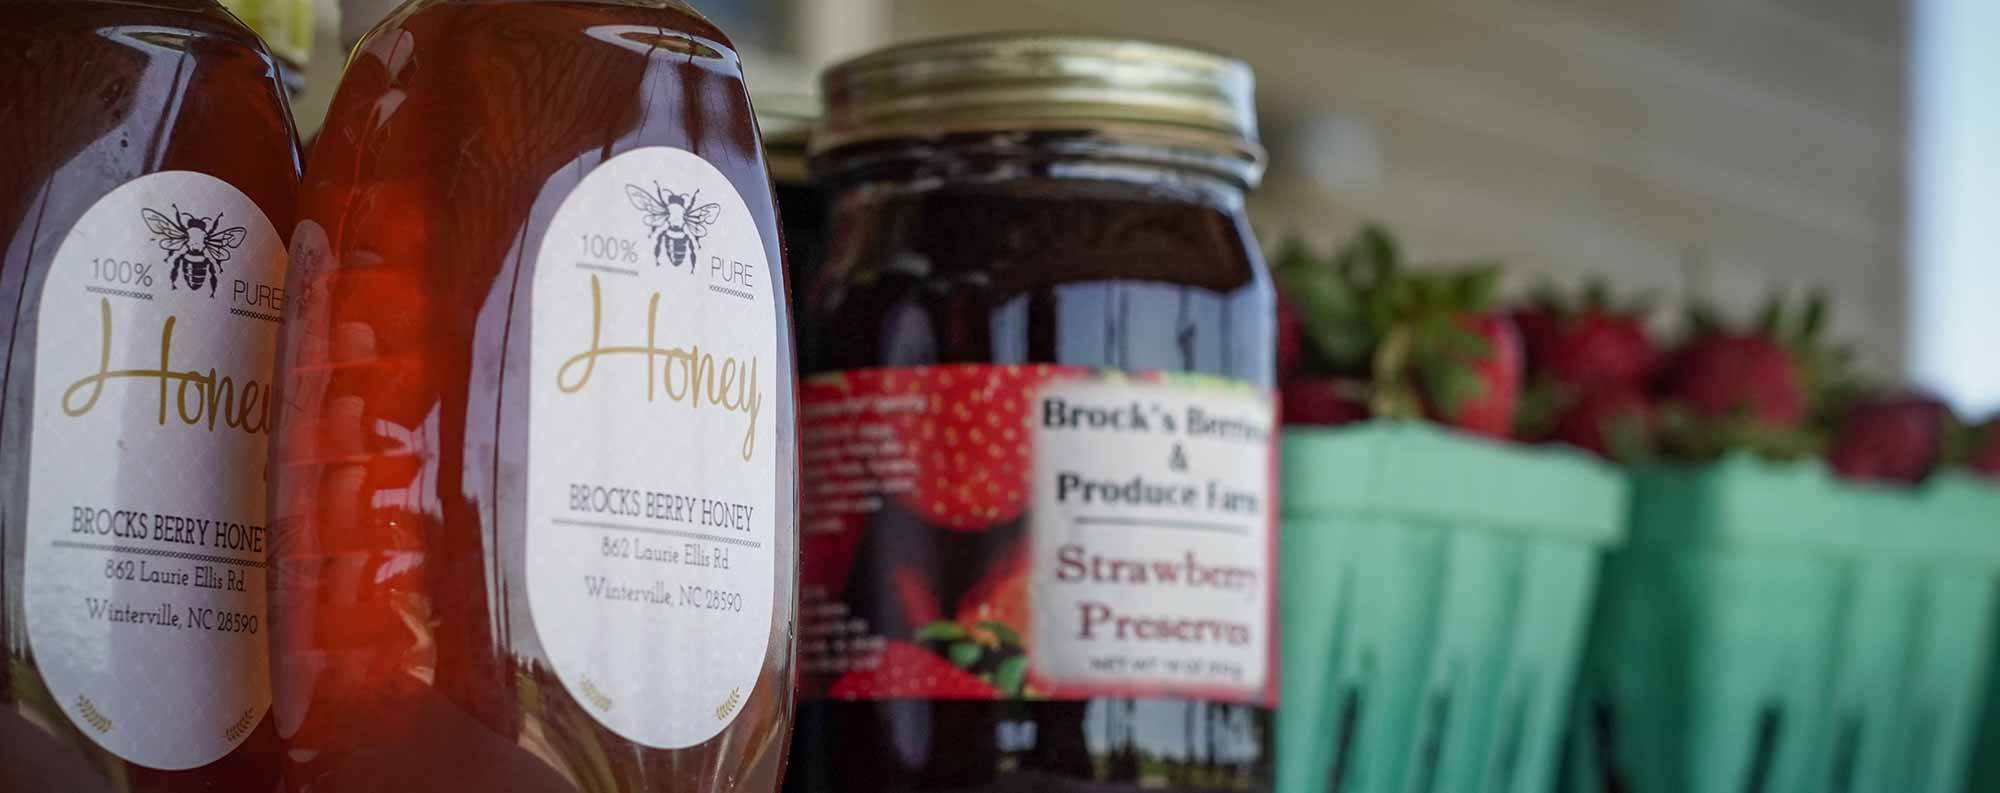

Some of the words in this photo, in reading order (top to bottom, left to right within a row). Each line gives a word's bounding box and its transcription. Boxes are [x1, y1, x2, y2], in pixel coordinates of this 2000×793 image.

[579, 233, 639, 264] 100%
[92, 257, 153, 287] 100%
[710, 256, 754, 288] PURE
[232, 279, 285, 311] PURE
[62, 297, 272, 434] Hone
[557, 272, 762, 462] Honey
[1042, 400, 1176, 433] Brock's
[1168, 442, 1189, 472] &
[1055, 471, 1197, 507] Produce
[568, 484, 640, 517] BROCKS
[645, 492, 696, 522] BERRY
[700, 498, 753, 532] HONEY
[72, 505, 148, 540] BROCKS
[153, 513, 210, 546] BERRY
[214, 520, 267, 553] HONE
[601, 536, 630, 559] 862
[634, 537, 679, 564] Laurie
[684, 544, 710, 567] Ellis
[104, 559, 135, 581] 862
[139, 560, 189, 586] Laurie
[194, 566, 224, 590] Ellis
[679, 584, 703, 608] NC
[705, 590, 743, 613] 28590
[85, 598, 183, 631] Winterville,
[187, 607, 213, 630] NC
[216, 613, 258, 635] 28590
